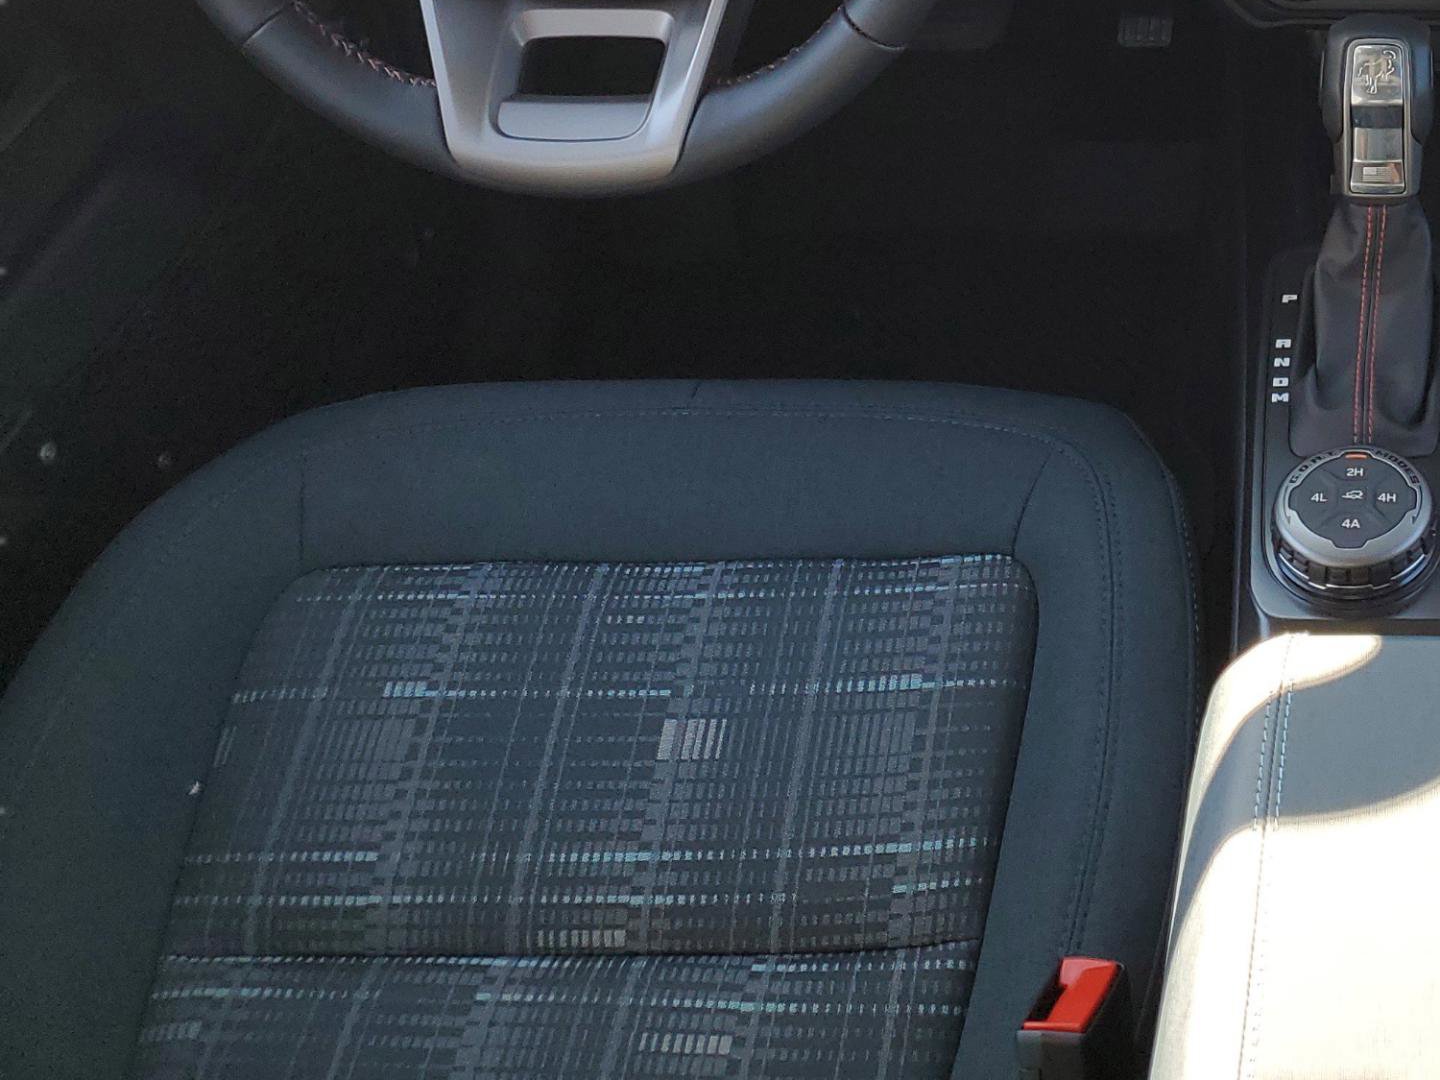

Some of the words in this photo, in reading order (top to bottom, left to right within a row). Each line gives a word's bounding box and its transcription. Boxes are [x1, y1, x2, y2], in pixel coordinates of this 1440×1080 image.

[1274, 357, 1290, 367] N
[1272, 377, 1289, 387] D
[1271, 392, 1289, 402] M
[1346, 468, 1364, 477] 2H
[1311, 493, 1328, 502] 4L
[1377, 493, 1397, 502] 4H
[1341, 519, 1361, 529] 4A
